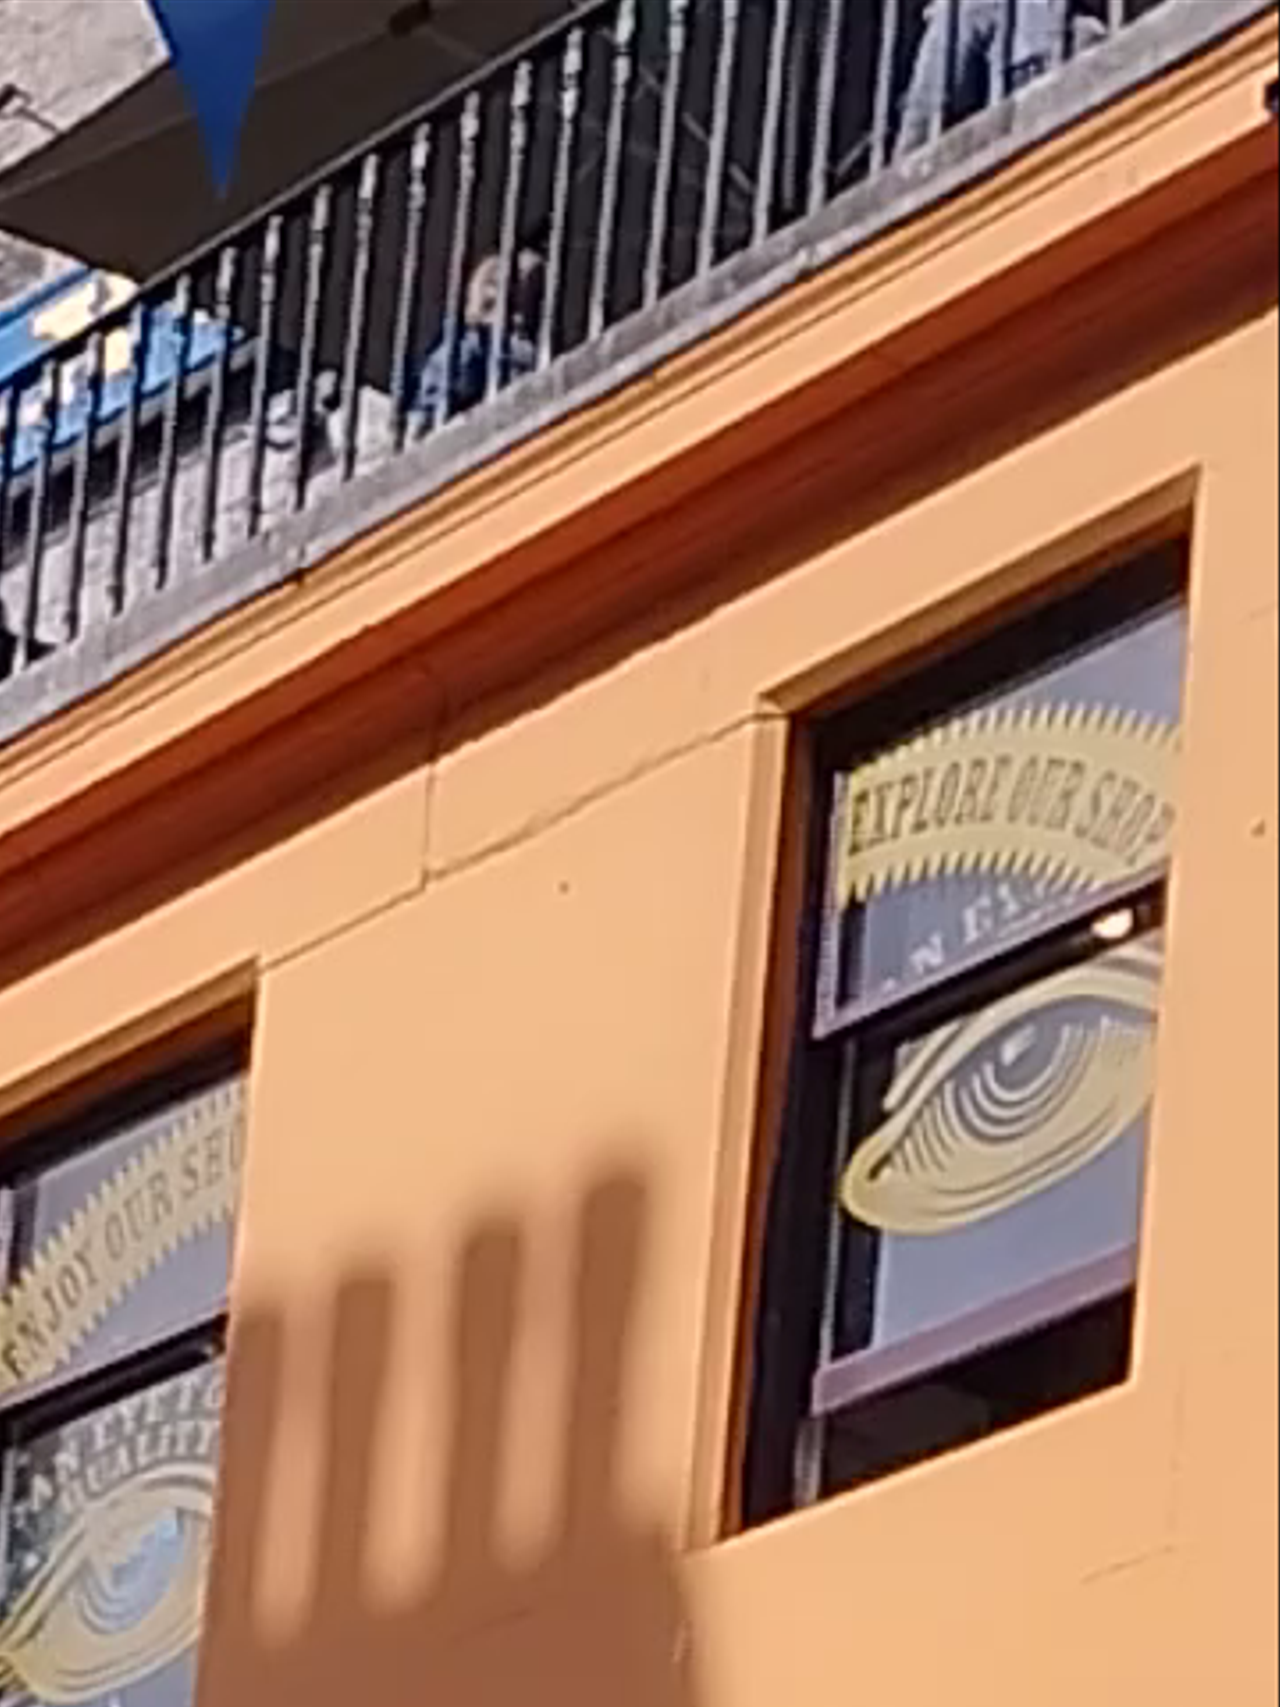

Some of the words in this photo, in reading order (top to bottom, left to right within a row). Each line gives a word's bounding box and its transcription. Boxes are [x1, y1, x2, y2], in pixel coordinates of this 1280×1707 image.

[848, 754, 1012, 857] EXPLORE
[1007, 753, 1087, 831] OUR
[0, 1238, 100, 1382] ENJOY
[103, 1167, 176, 1262] OUR
